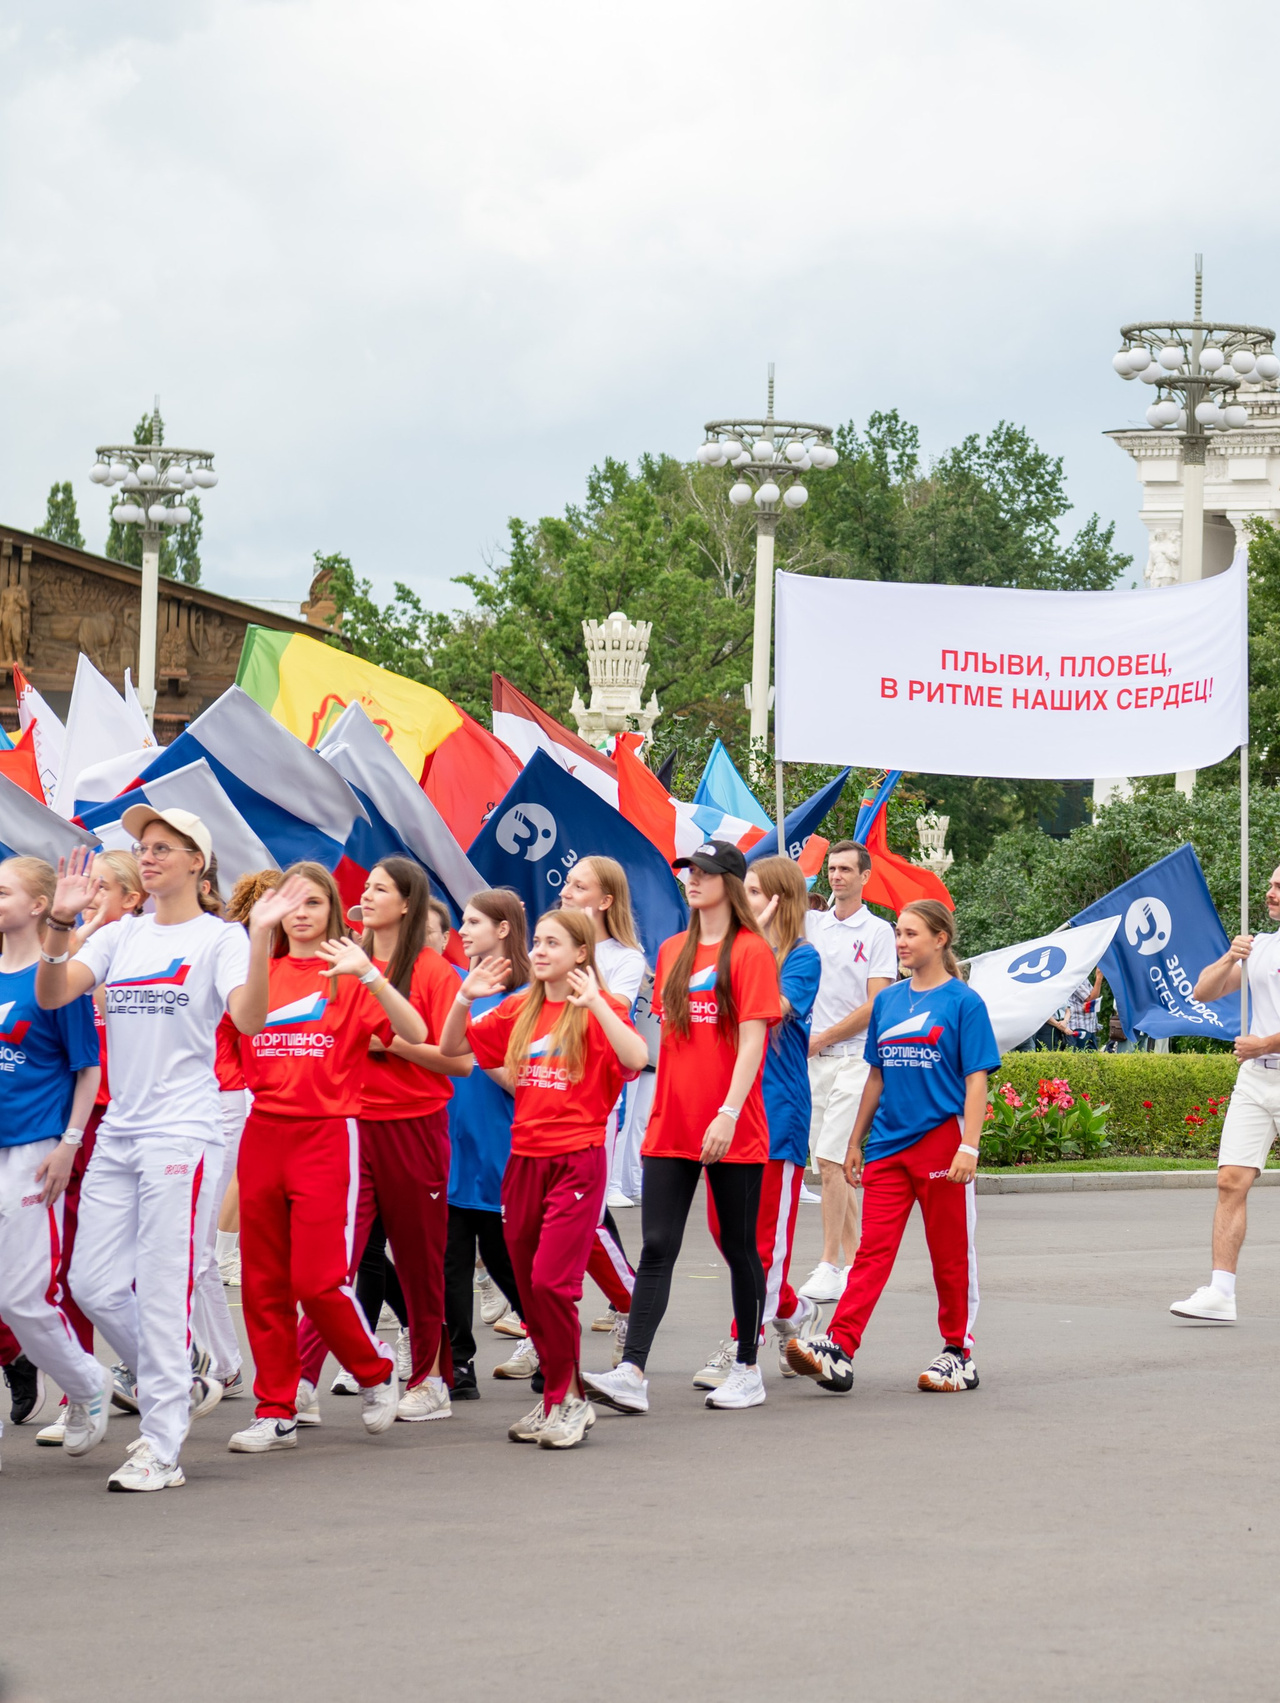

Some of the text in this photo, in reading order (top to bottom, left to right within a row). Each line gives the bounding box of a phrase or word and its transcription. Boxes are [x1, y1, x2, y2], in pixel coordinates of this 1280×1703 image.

[942, 650, 1172, 680] ПЛЫВИ, ПЛОВЕЦ,
[881, 677, 1213, 711] В РИТМЕ НАШИХ СЕРДЕЦ!
